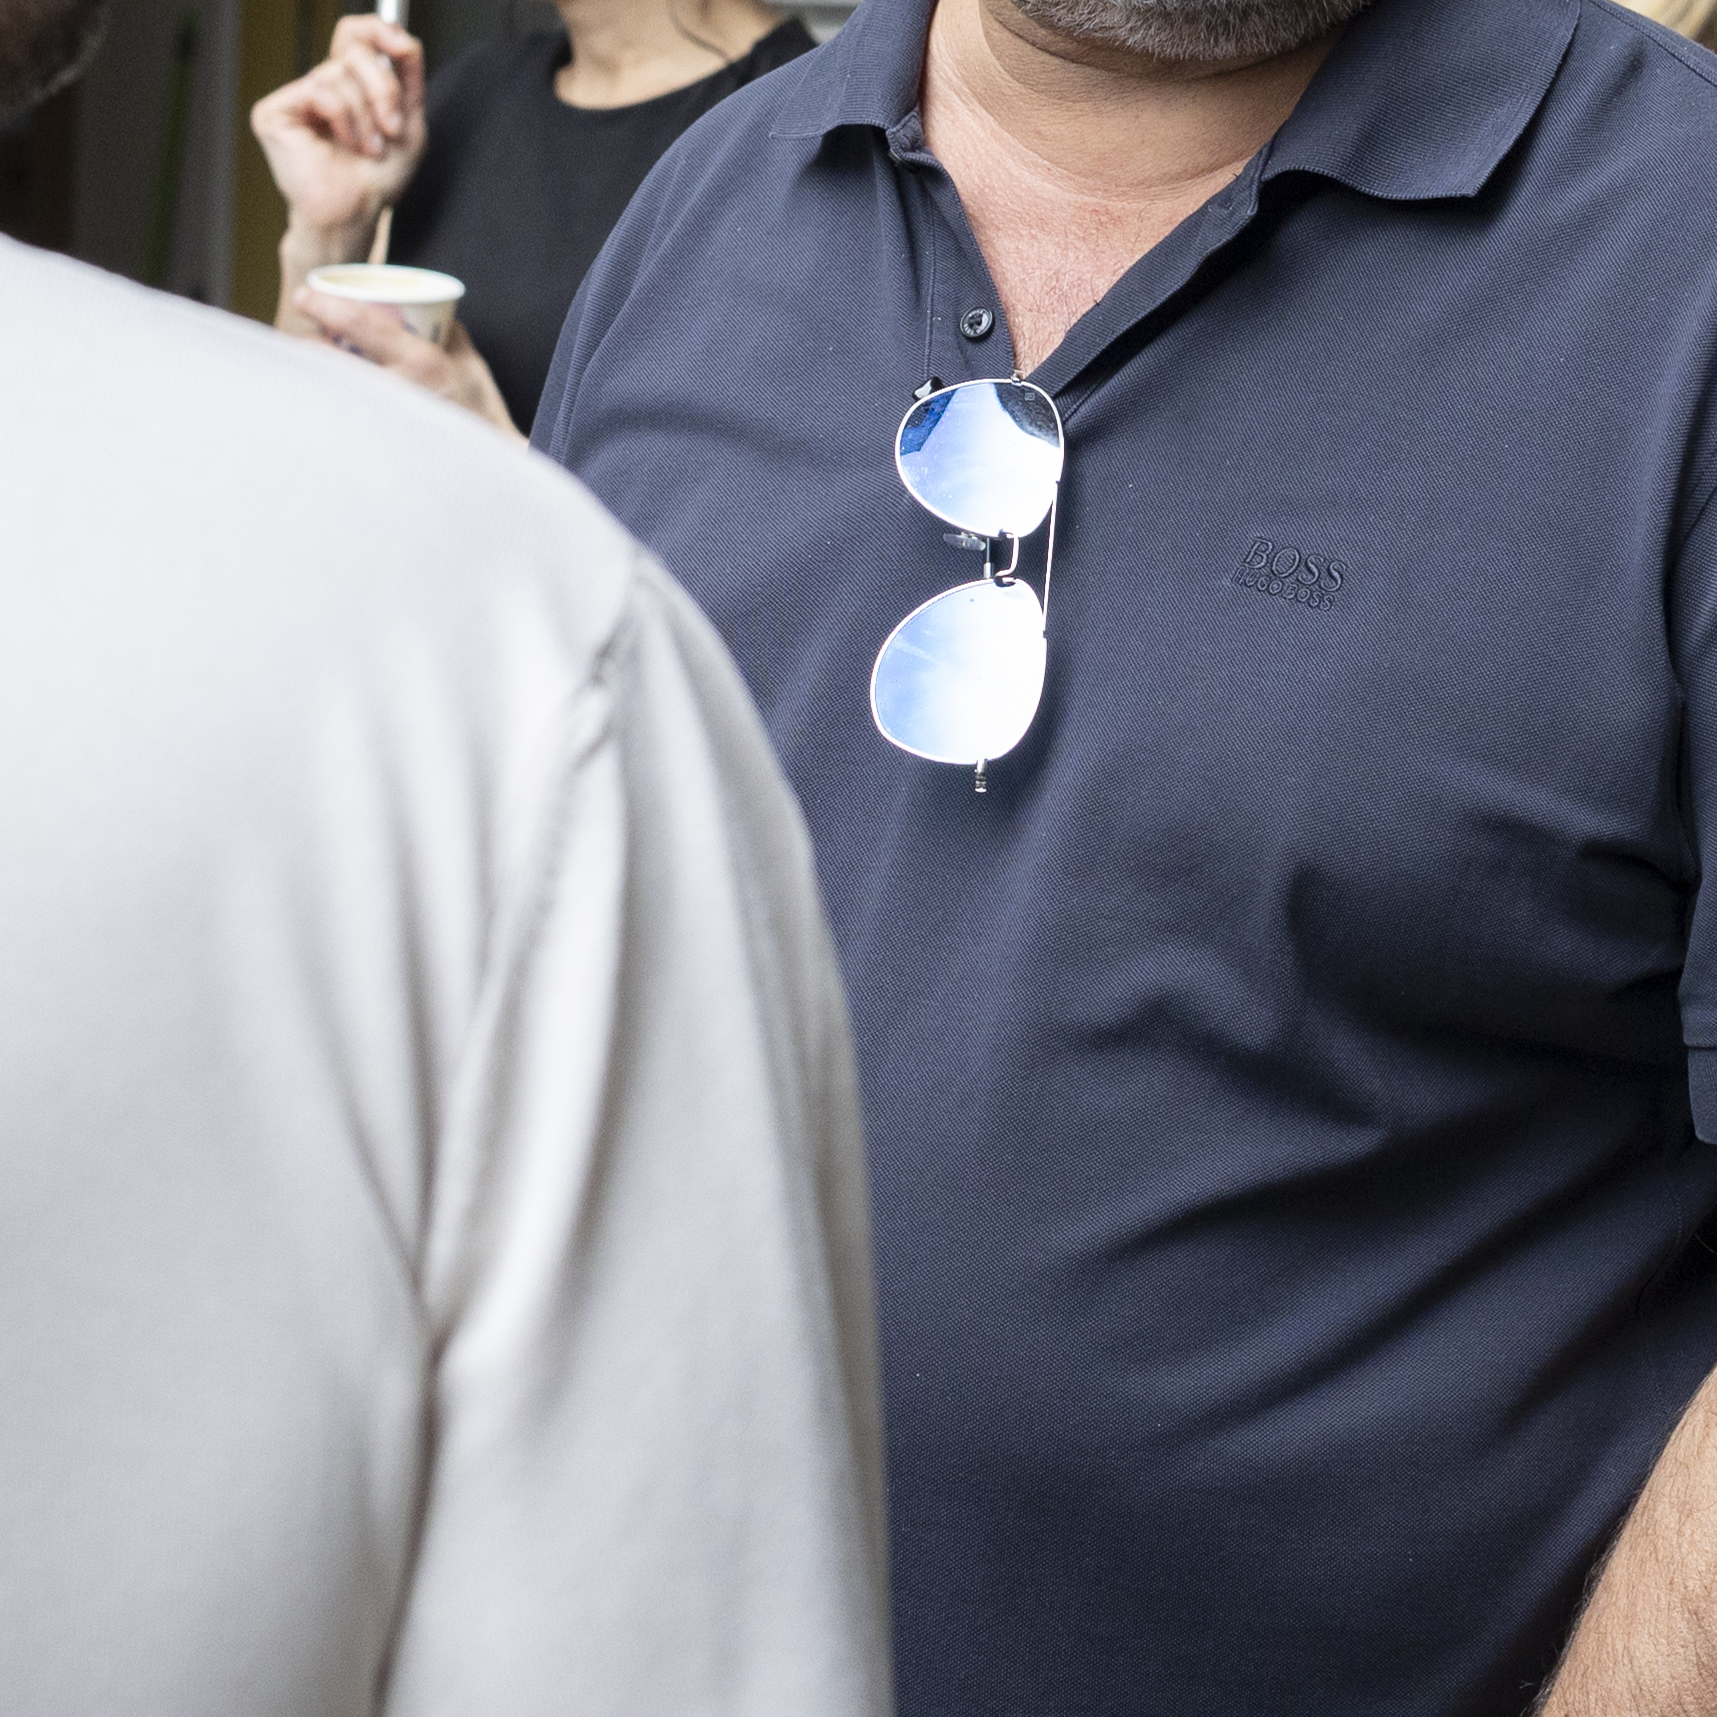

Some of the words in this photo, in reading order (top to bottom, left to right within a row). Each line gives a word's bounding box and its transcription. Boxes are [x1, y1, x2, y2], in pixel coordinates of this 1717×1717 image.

[1233, 565, 1283, 595] HUGO
[1283, 584, 1334, 611] BOSS
[1243, 537, 1347, 592] BOSS
